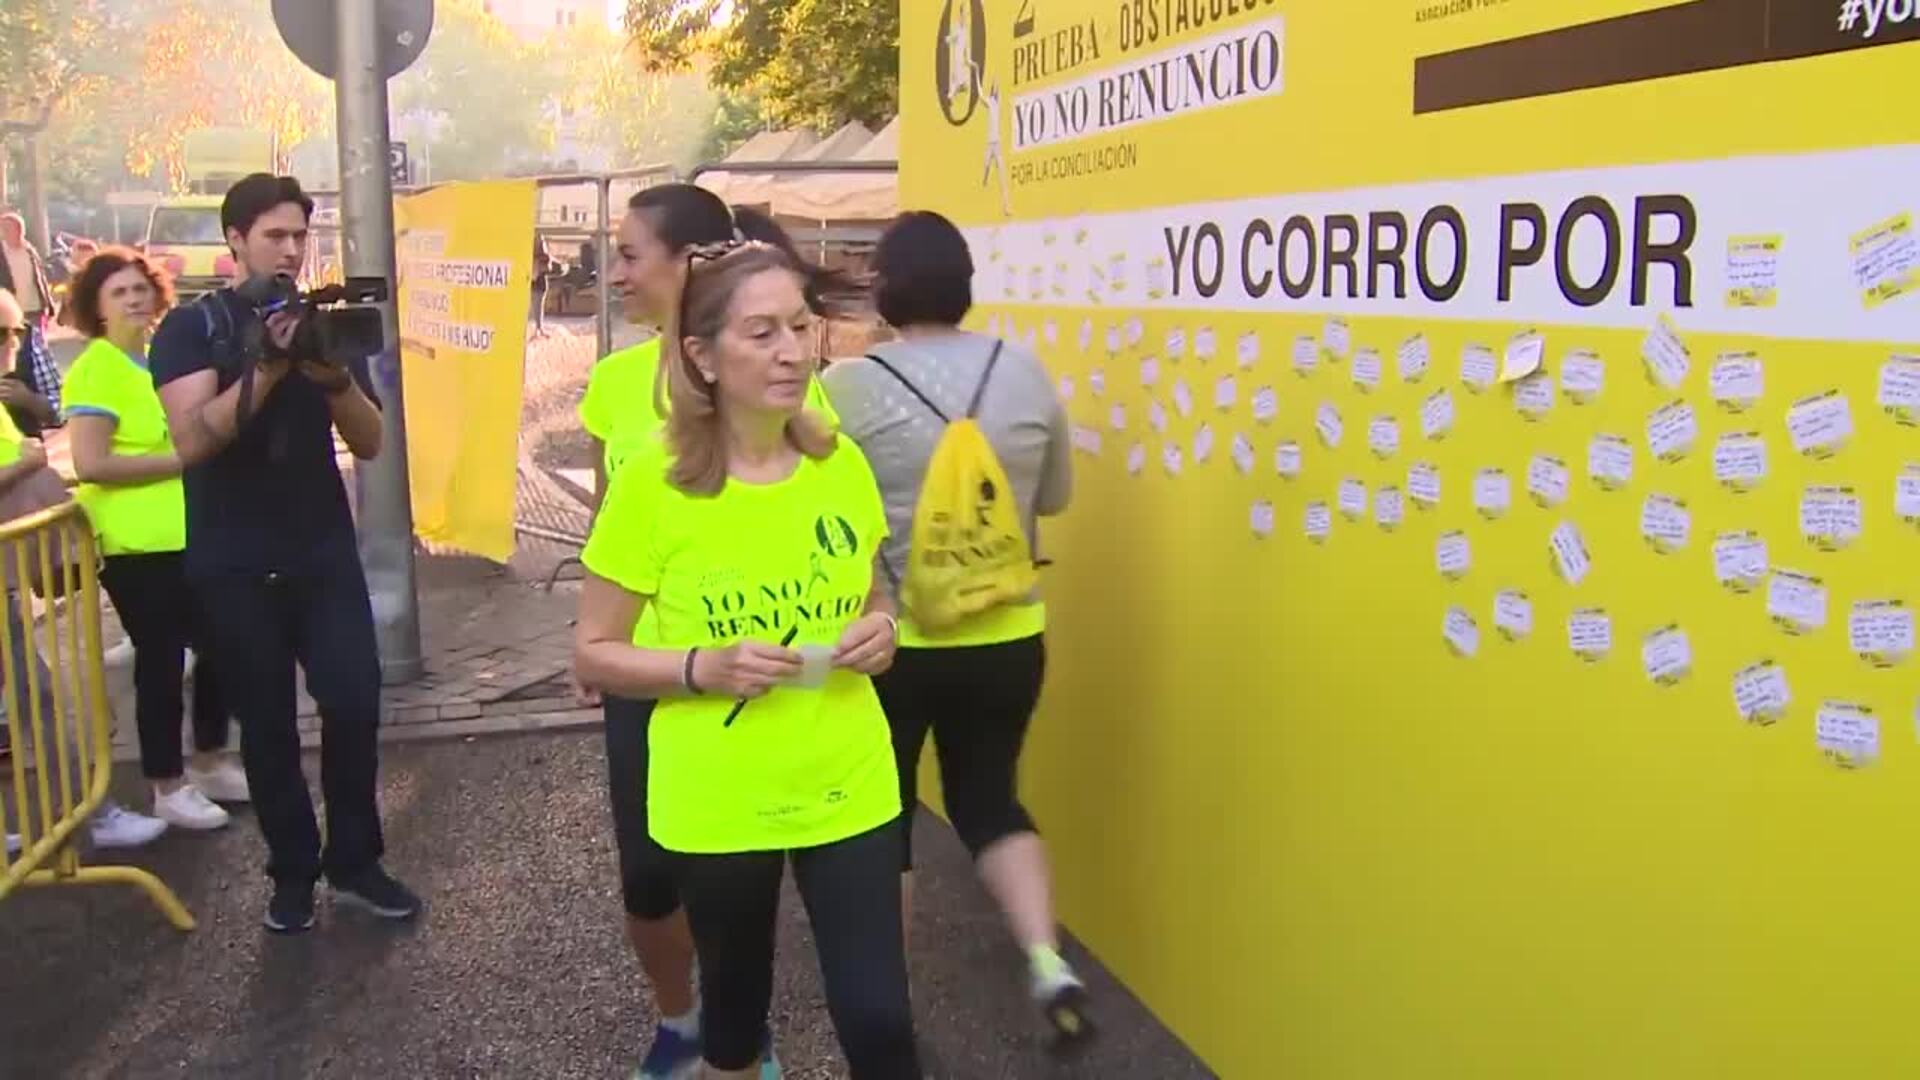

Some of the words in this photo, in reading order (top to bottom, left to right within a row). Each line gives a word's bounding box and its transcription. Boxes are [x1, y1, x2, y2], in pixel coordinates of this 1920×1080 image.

[1013, 18, 1100, 85] PRUEBA
[1015, 98, 1045, 147] YO
[1054, 86, 1089, 138] NO
[1098, 30, 1280, 127] RENUNCIO
[1164, 221, 1225, 298] YO
[1240, 204, 1468, 303] CORRO
[1496, 194, 1698, 308] POR
[702, 590, 745, 615] YO
[760, 578, 802, 606] NO
[707, 594, 862, 639] RENUNCIO
